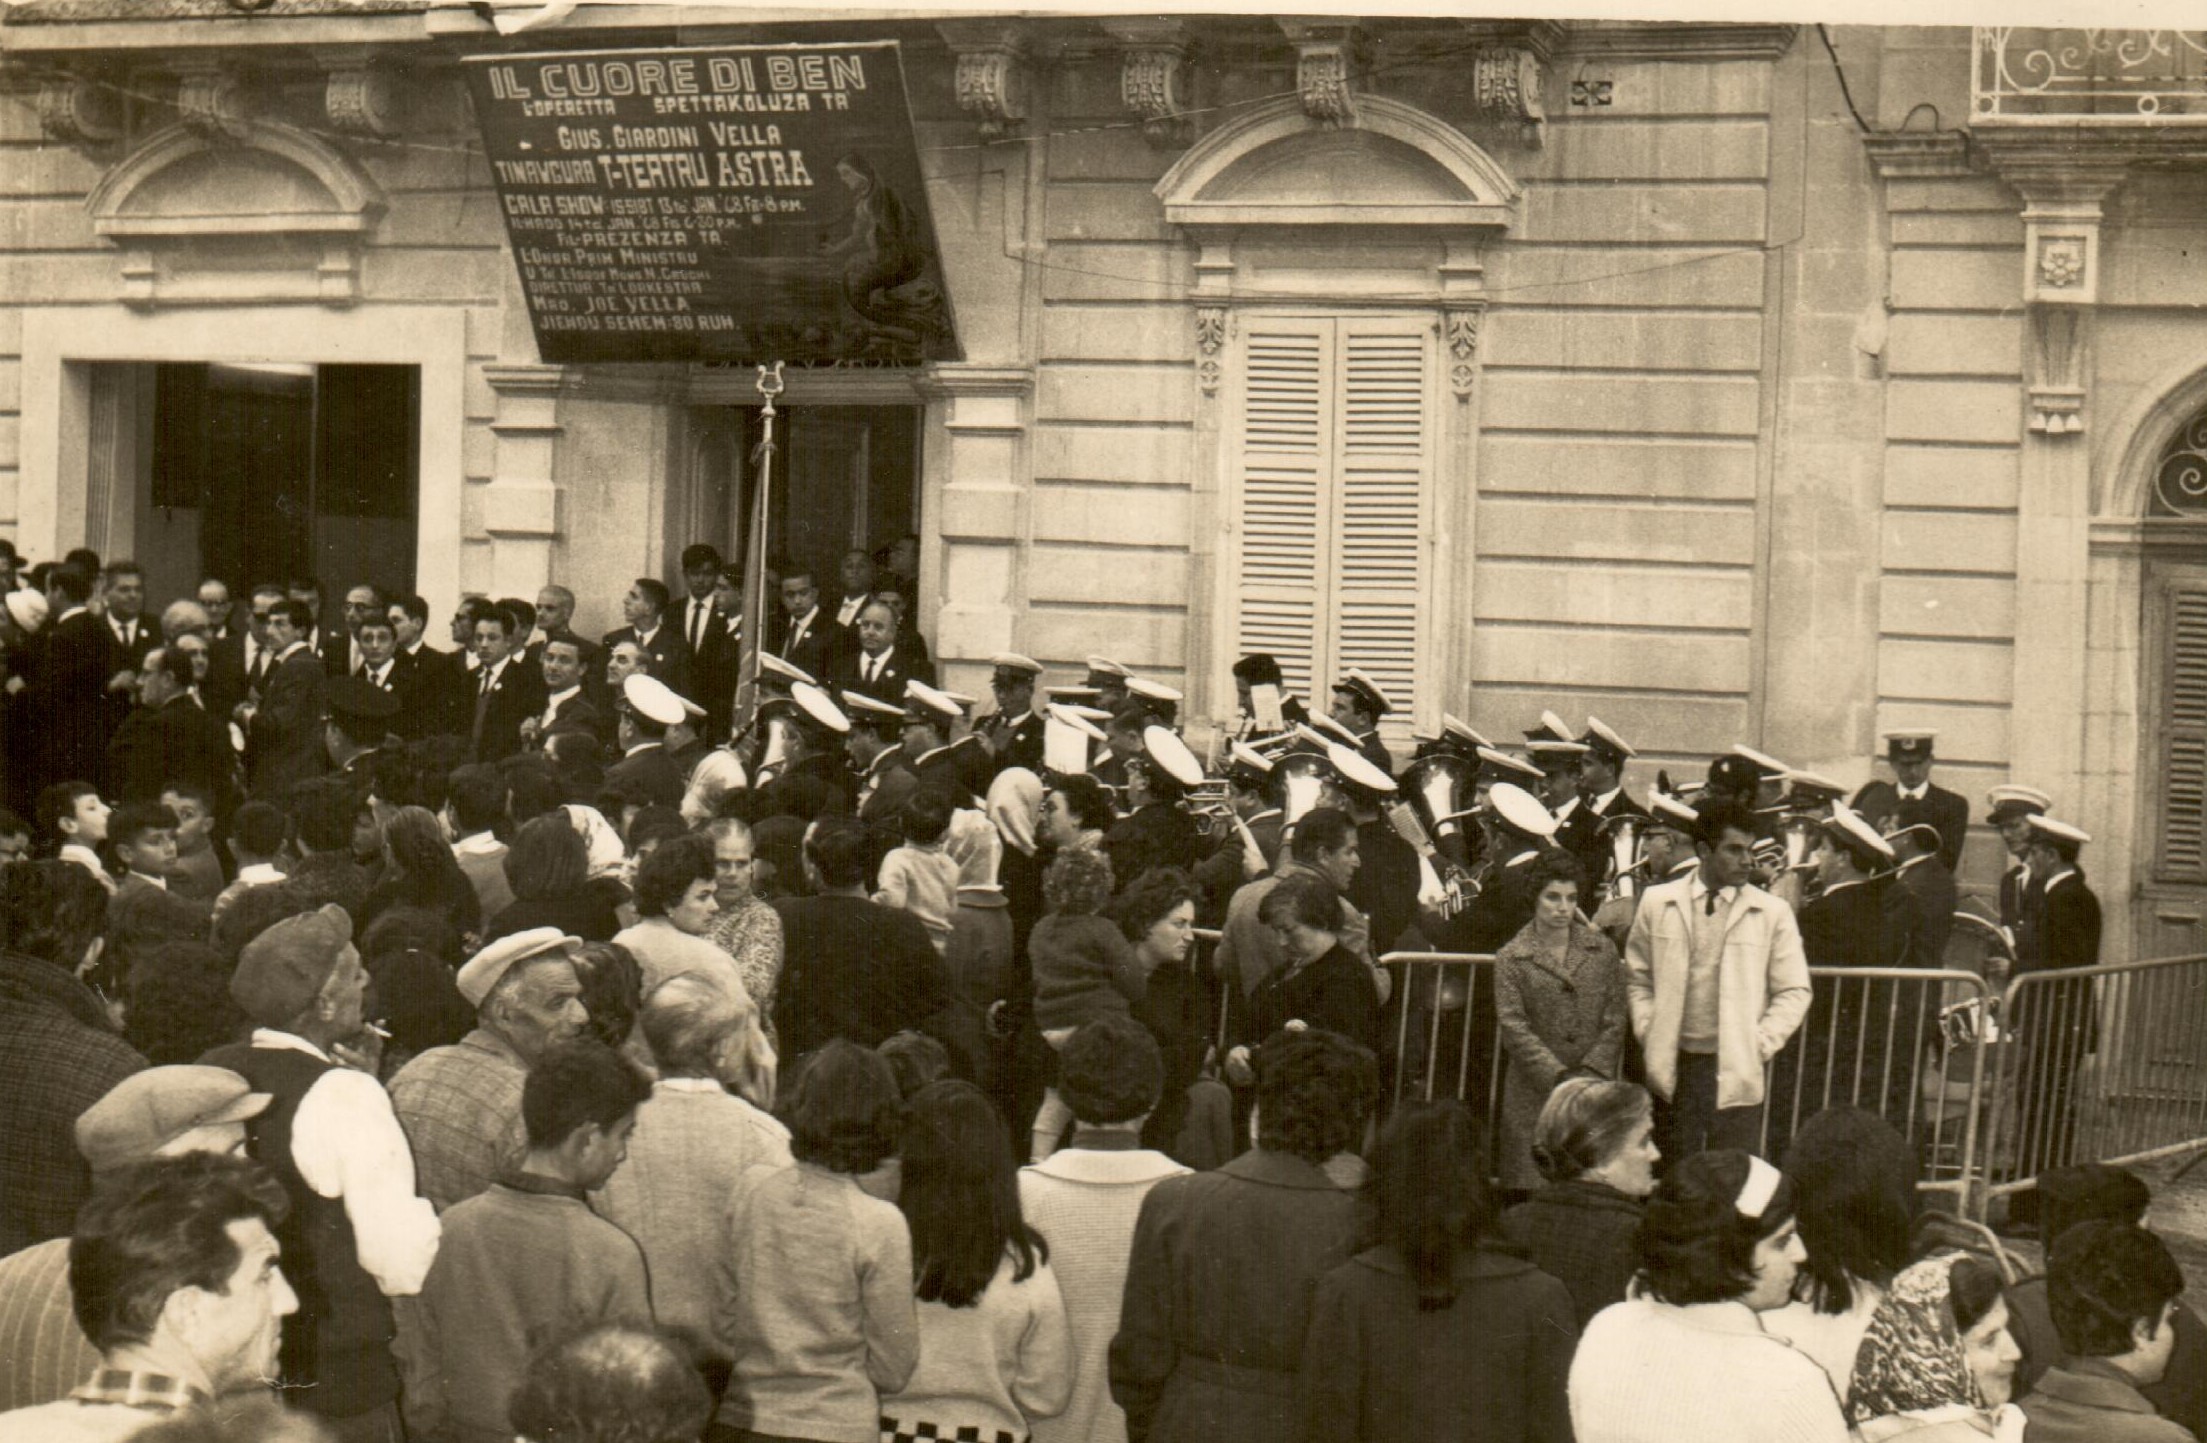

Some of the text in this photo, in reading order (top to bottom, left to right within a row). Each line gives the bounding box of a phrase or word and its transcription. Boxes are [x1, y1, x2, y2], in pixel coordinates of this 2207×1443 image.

[489, 55, 867, 99] IL CUORE DI BEN
[654, 92, 811, 114] SPETTAKOLUZA
[612, 124, 700, 149] GIARDINI
[708, 121, 782, 147] VELLA
[597, 153, 710, 189] T-TEATRU
[716, 149, 814, 187] ASTRA
[504, 194, 555, 215] GALA
[555, 194, 604, 216] SHOW
[584, 296, 620, 315] JOE
